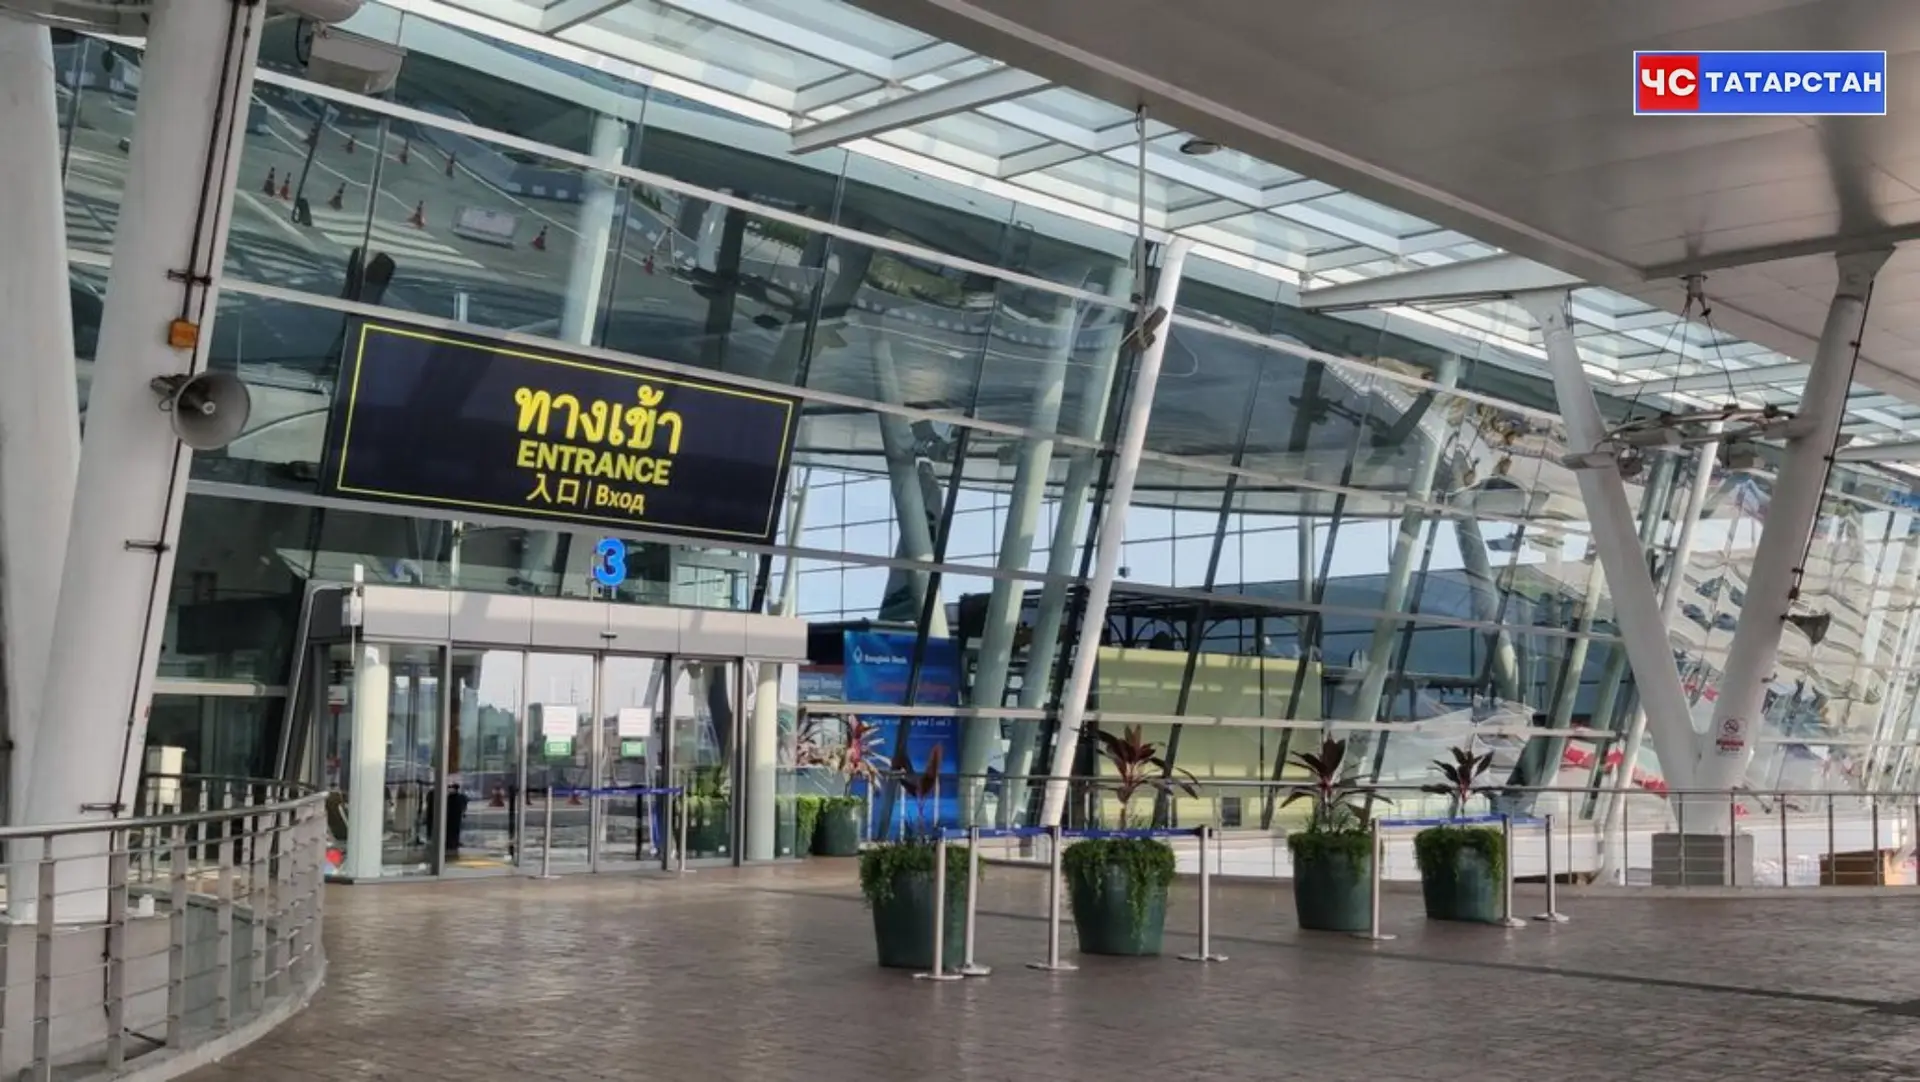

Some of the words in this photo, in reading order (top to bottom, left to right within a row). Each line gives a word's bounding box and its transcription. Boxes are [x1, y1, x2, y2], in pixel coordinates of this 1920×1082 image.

[514, 384, 684, 455] ทางเข้า
[516, 439, 673, 487] ENTRANCE
[526, 473, 581, 506] 入口
[595, 484, 646, 516] Вход
[596, 537, 627, 586] 3
